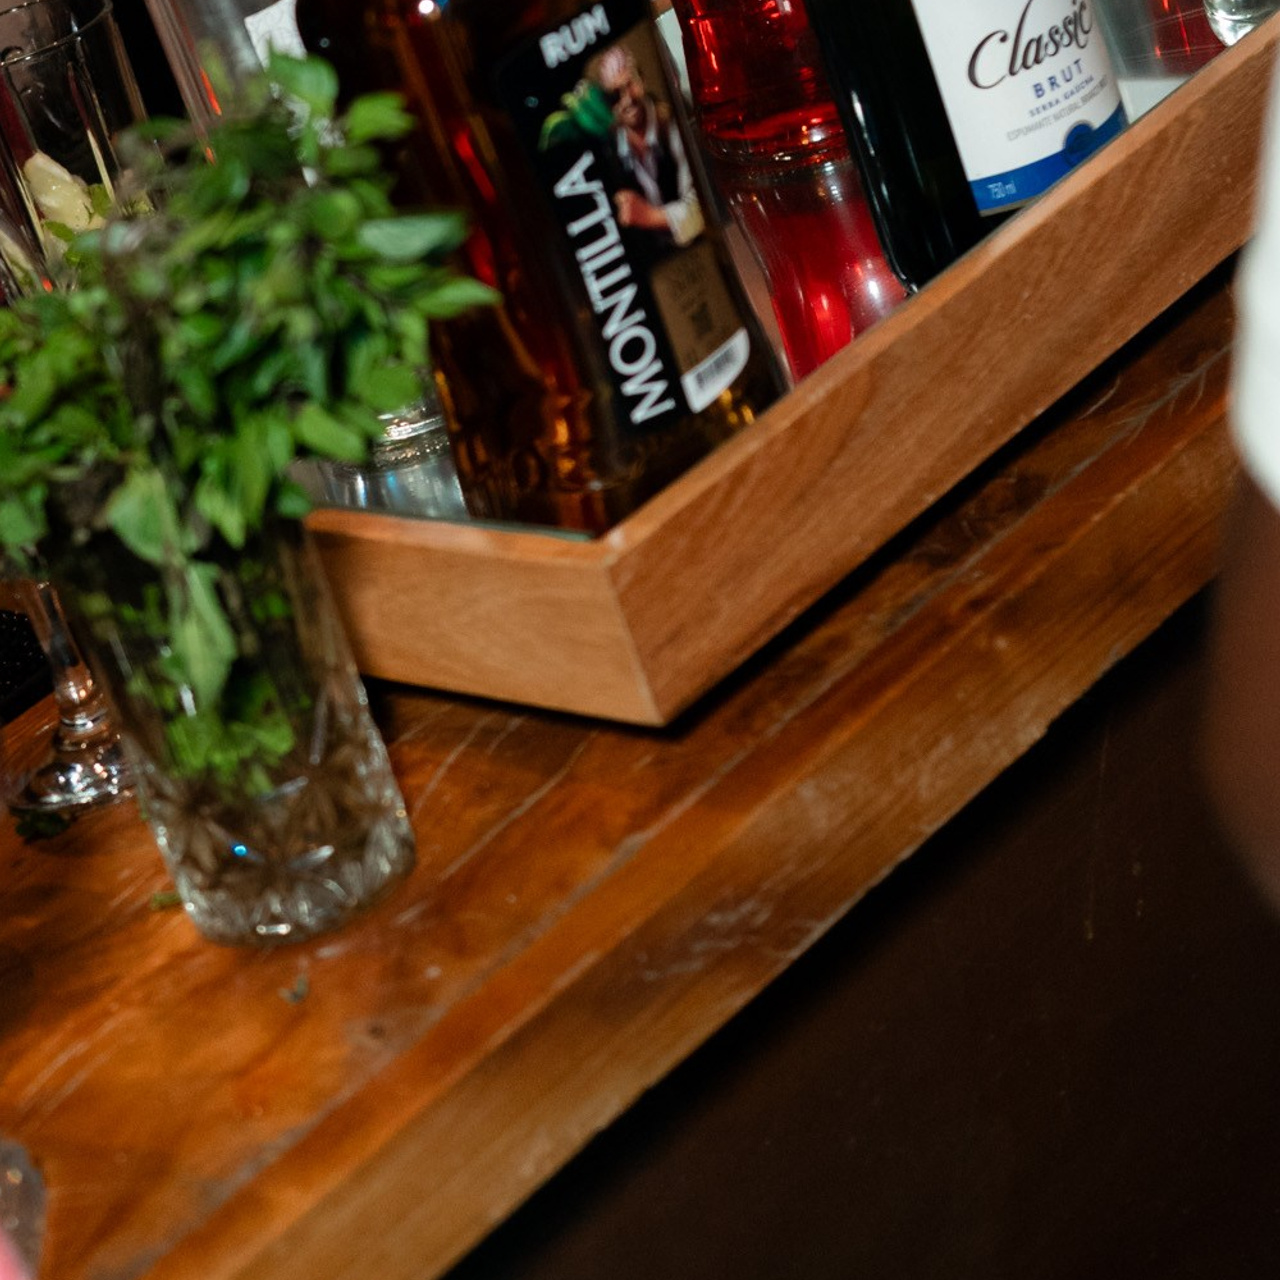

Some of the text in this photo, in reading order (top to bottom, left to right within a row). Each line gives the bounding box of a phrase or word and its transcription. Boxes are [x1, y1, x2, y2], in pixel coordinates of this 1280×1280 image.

[539, 3, 611, 68] RUM
[1032, 58, 1083, 99] BRUT
[553, 150, 676, 425] MONTILLA
